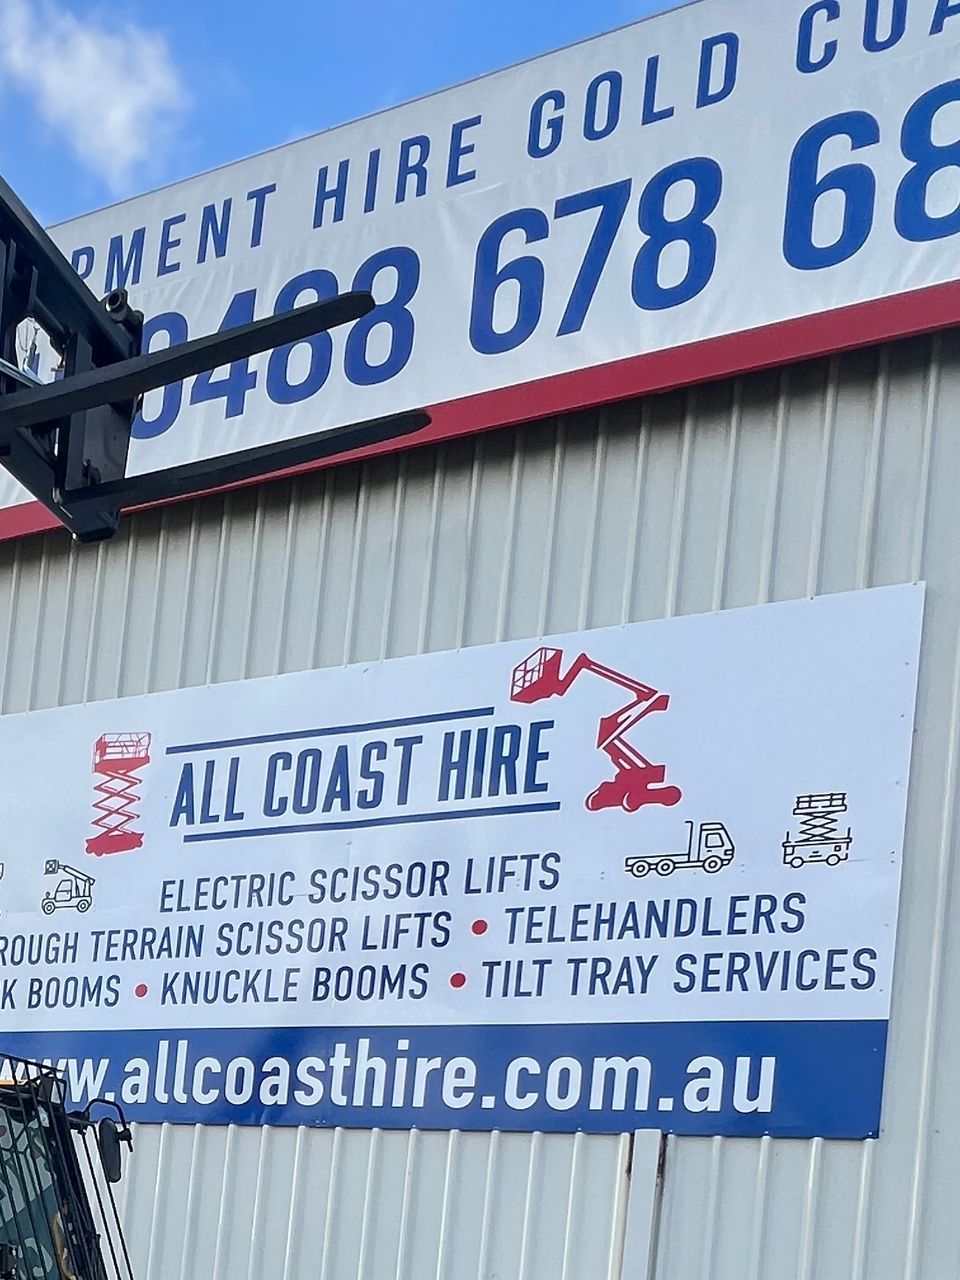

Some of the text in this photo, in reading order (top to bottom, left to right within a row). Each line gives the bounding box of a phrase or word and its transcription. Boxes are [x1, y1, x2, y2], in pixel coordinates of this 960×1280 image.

[312, 115, 482, 229] HIRE
[528, 31, 739, 159] GOLD
[131, 77, 960, 440] 0488 678 68
[169, 719, 555, 828] ALL COAST HIRE
[90, 924, 205, 963] TERRAIN
[216, 915, 348, 957] SCISSOR
[361, 911, 452, 950] LIFTS
[504, 892, 807, 945] TELEHANDLERS
[159, 852, 562, 913] ELECTRIC SCISSOR LIFTS
[27, 974, 121, 1009] BOOMS
[160, 967, 300, 1005] KNUCKLE
[312, 963, 430, 1002] BOOMS
[482, 958, 552, 998] TILT
[566, 955, 659, 996] TRAY
[673, 947, 878, 994] SERVICES
